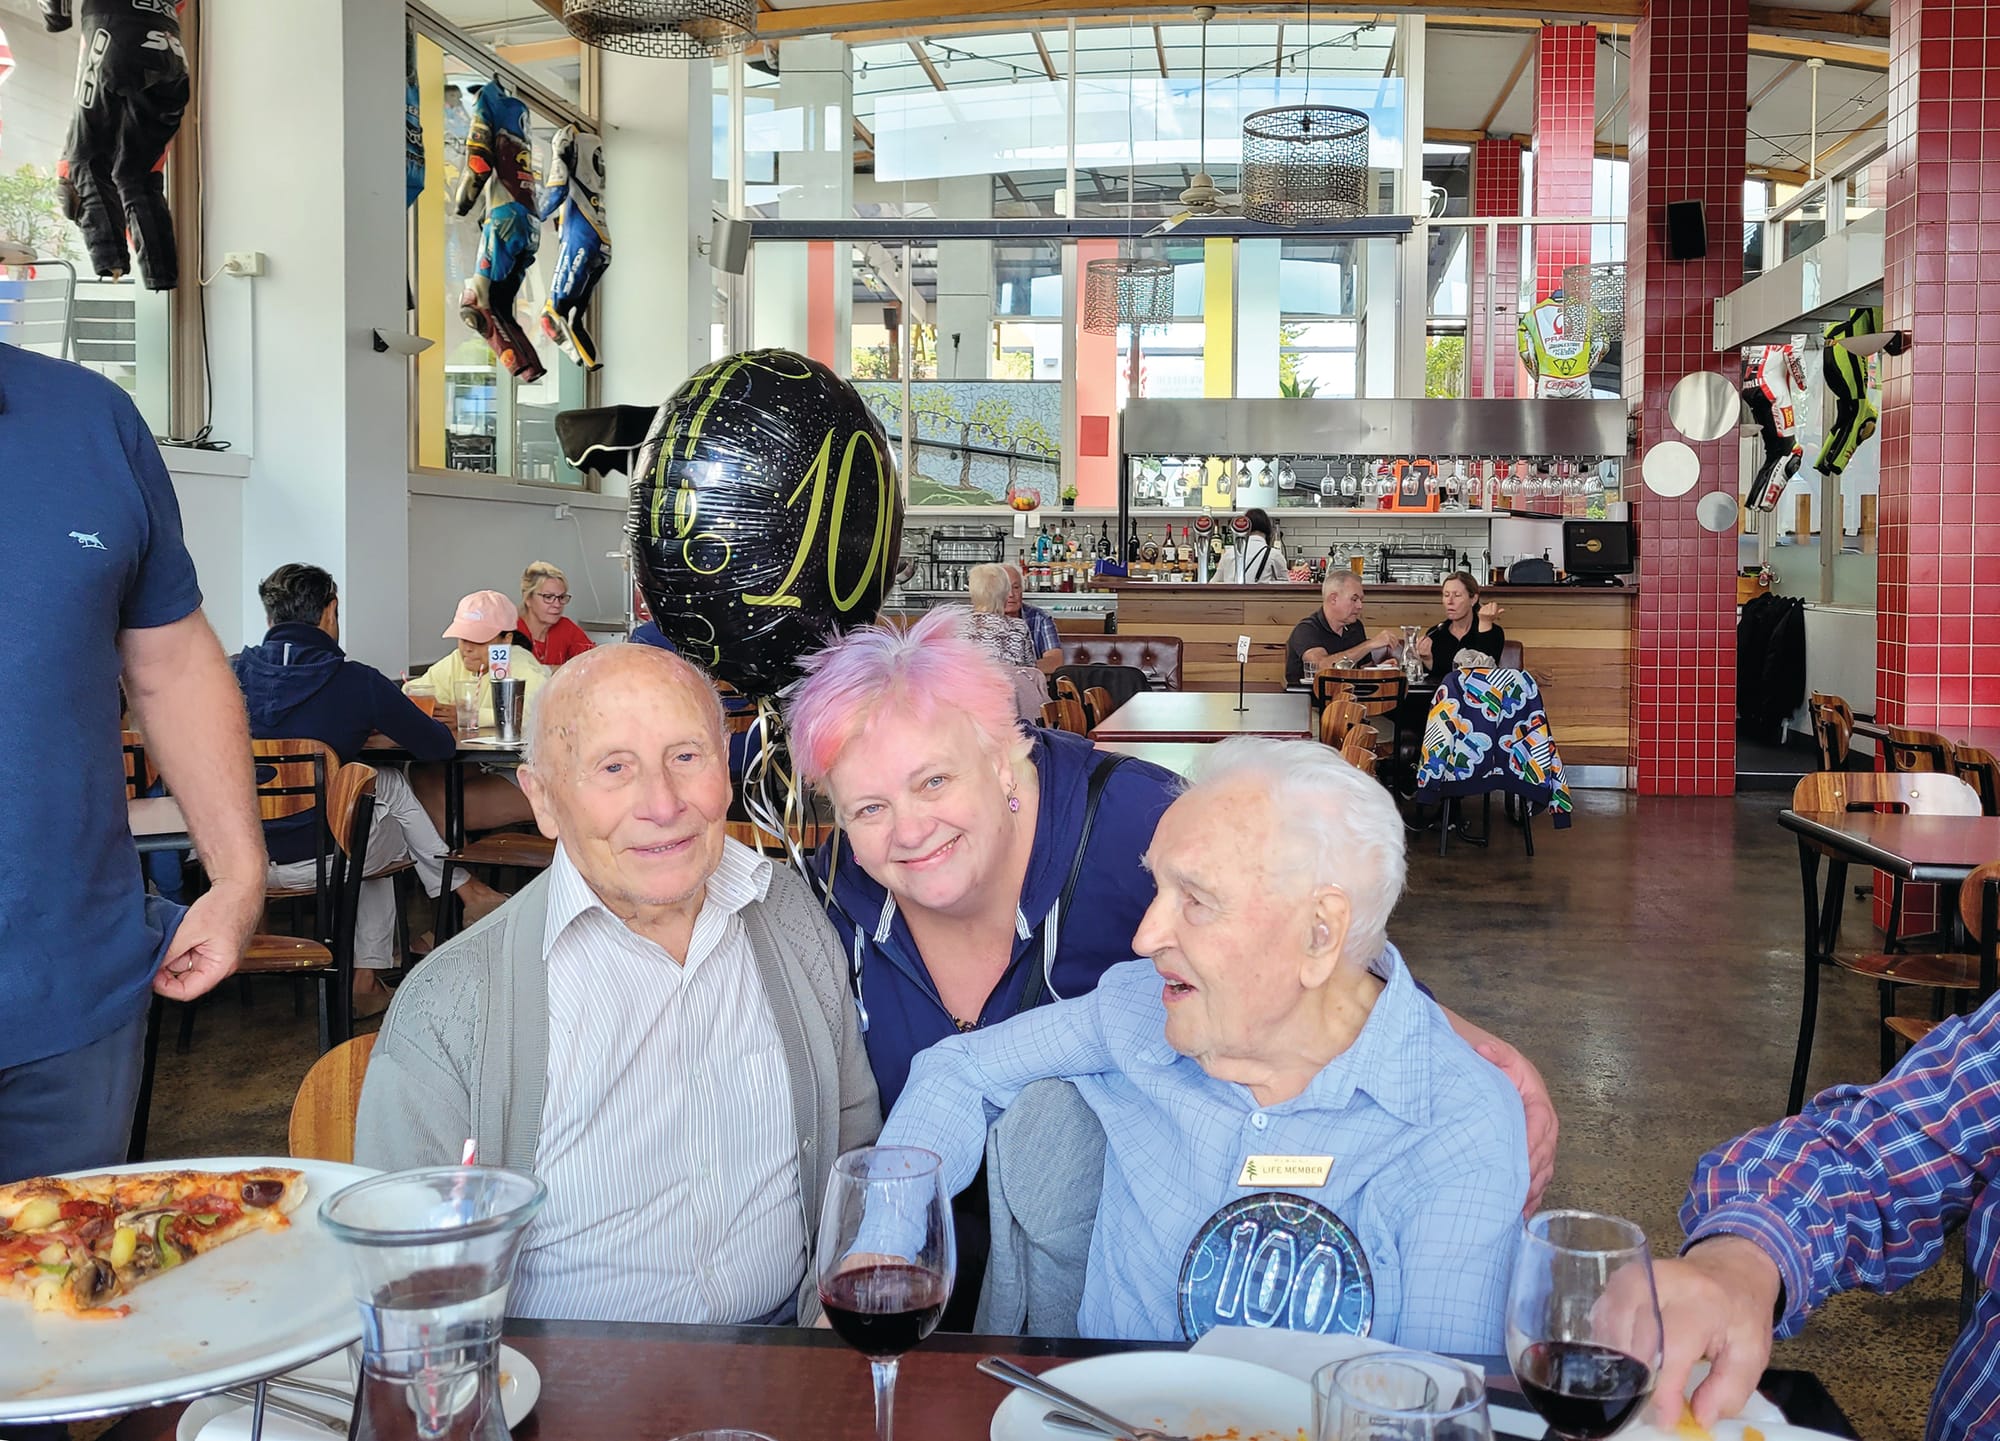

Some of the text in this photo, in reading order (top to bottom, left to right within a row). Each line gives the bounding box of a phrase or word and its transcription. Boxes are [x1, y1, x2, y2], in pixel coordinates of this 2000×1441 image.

[491, 649, 507, 661] 32
[1262, 1166, 1323, 1174] LIFE MEMBER
[1215, 1220, 1342, 1335] 100
